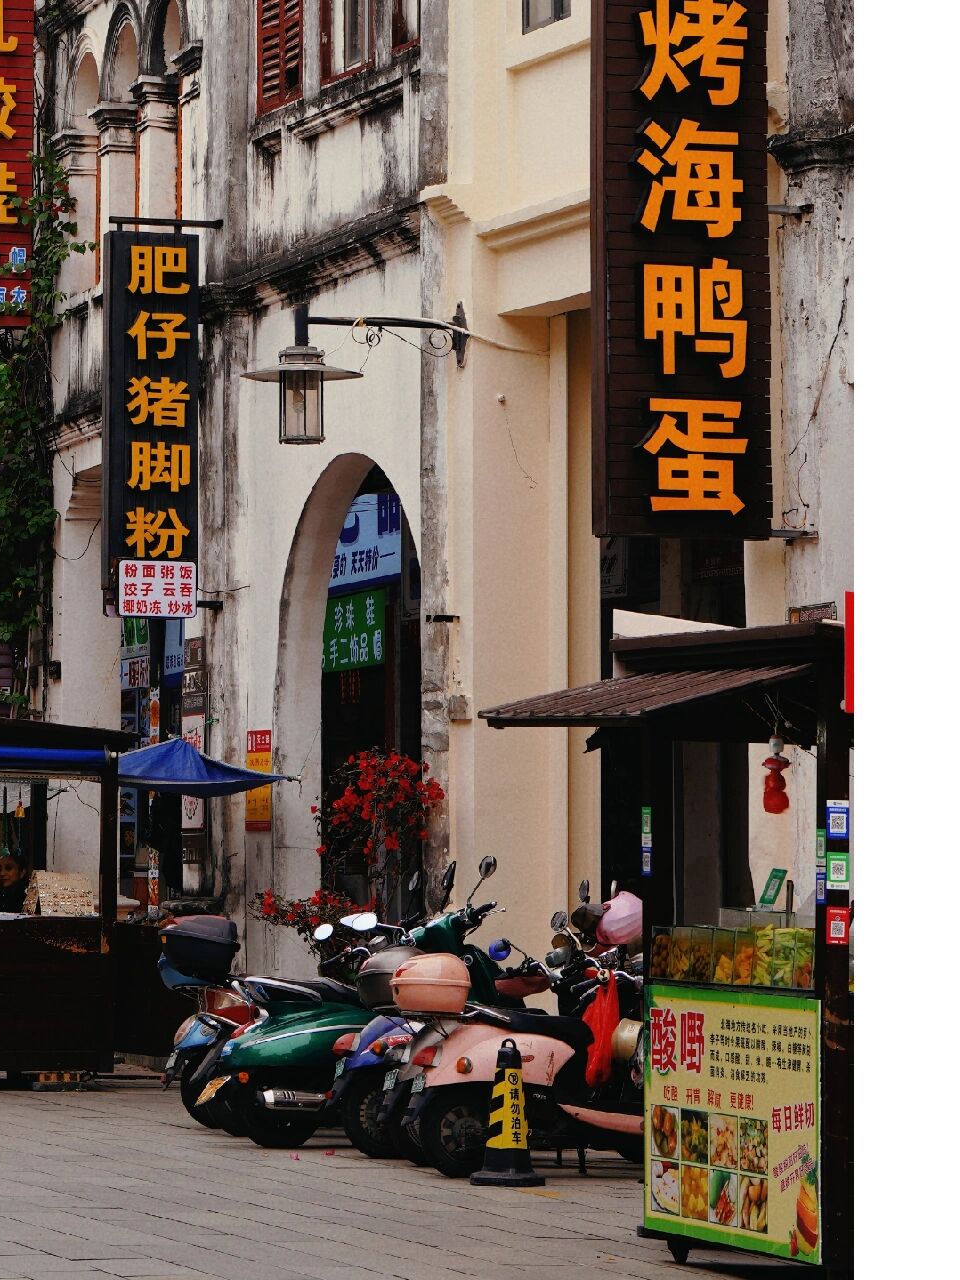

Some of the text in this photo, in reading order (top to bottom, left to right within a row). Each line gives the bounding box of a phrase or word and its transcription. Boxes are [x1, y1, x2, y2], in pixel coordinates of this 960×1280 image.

[125, 245, 191, 558] 肥仔猪脚粉
[124, 563, 193, 580] 粉面粥饭
[124, 582, 193, 597] 饺子 云吞
[123, 599, 193, 615] 椰奶冻 炒冰
[334, 599, 355, 633] 珍珠
[650, 1007, 705, 1074] 酸嘢
[685, 1088, 701, 1104] 开胃
[509, 1088, 522, 1145] 请勿泊车
[772, 1102, 815, 1133] 每日鲜切
